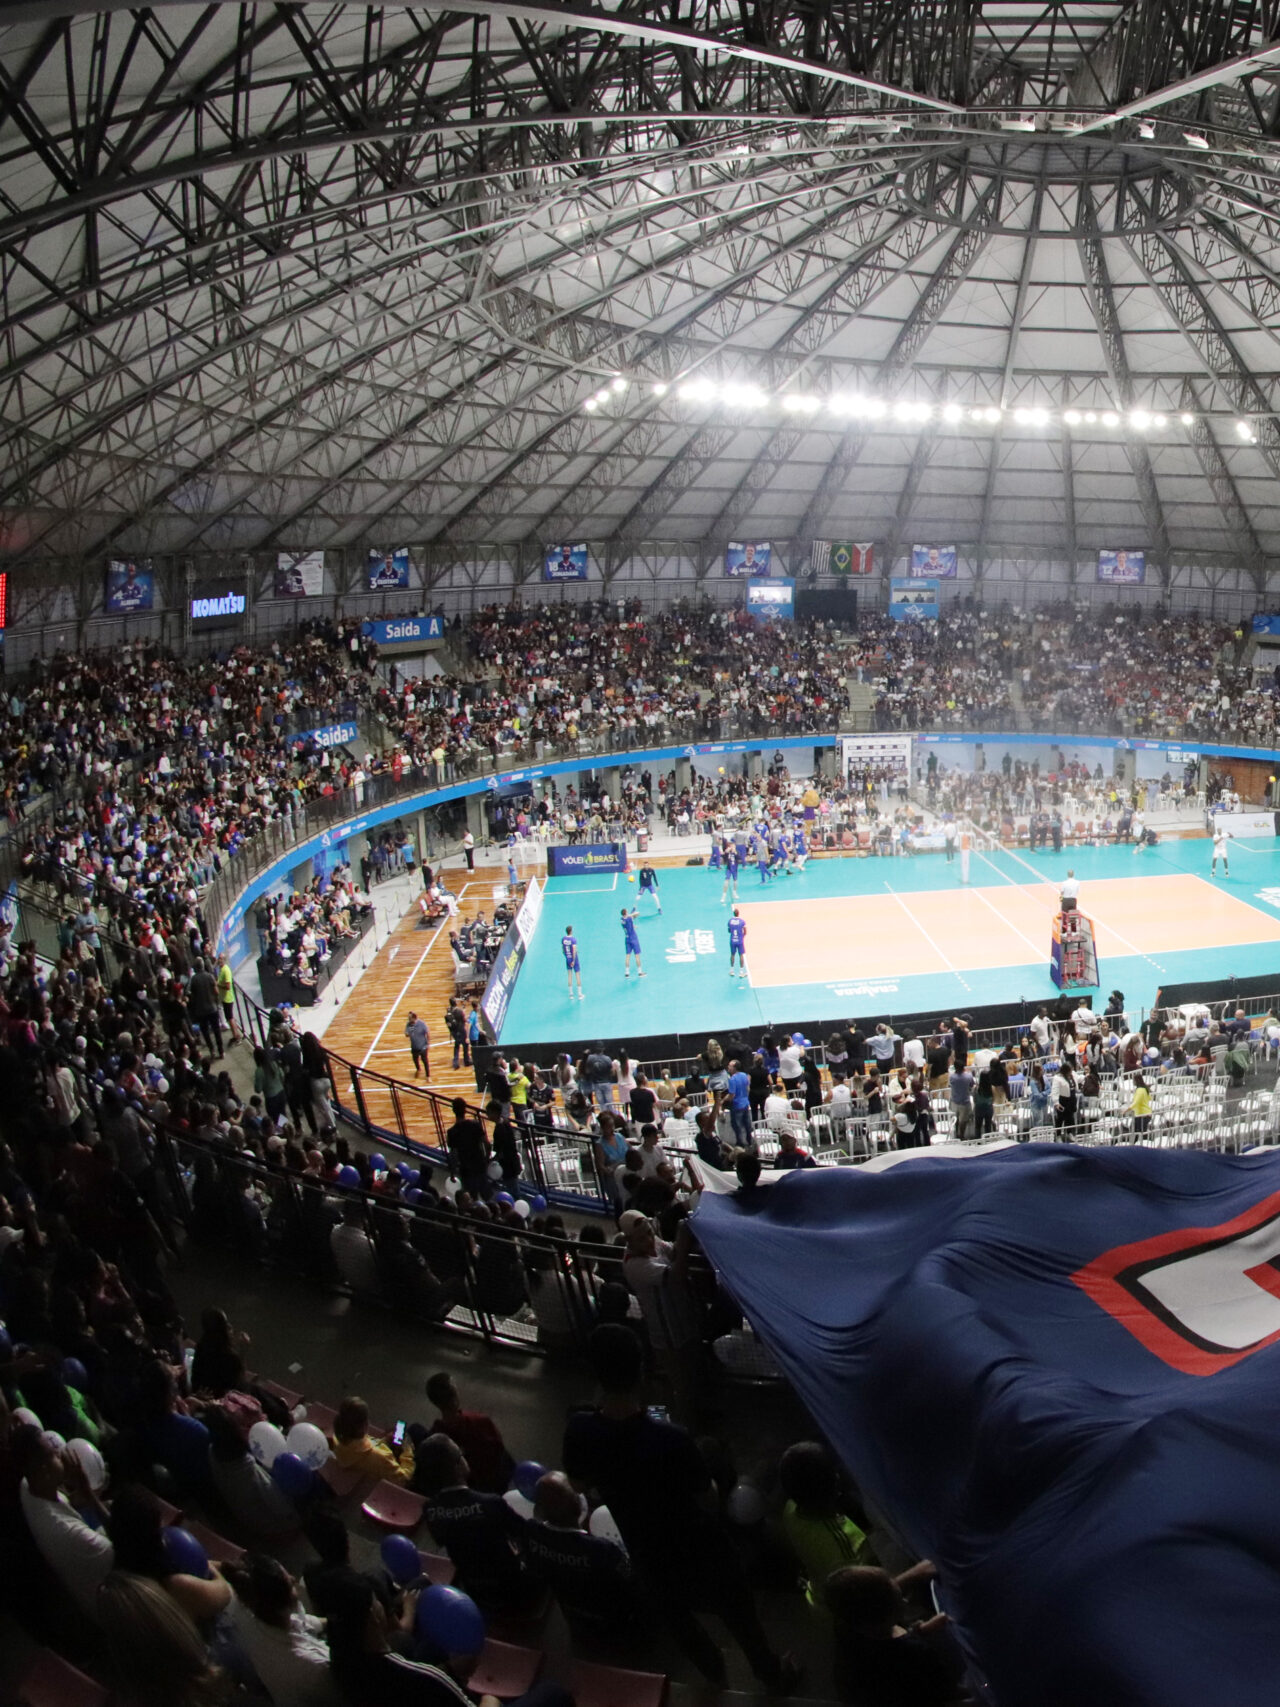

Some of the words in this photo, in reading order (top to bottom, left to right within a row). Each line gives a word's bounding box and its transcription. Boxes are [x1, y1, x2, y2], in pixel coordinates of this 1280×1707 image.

[370, 577, 377, 589] 3
[192, 592, 245, 618] KOMATSU
[386, 622, 420, 639] Saída
[430, 618, 439, 635] A
[349, 727, 354, 738] A
[562, 855, 584, 864] VÔLEI
[437, 1502, 484, 1520] Report
[539, 1543, 591, 1568] Report
